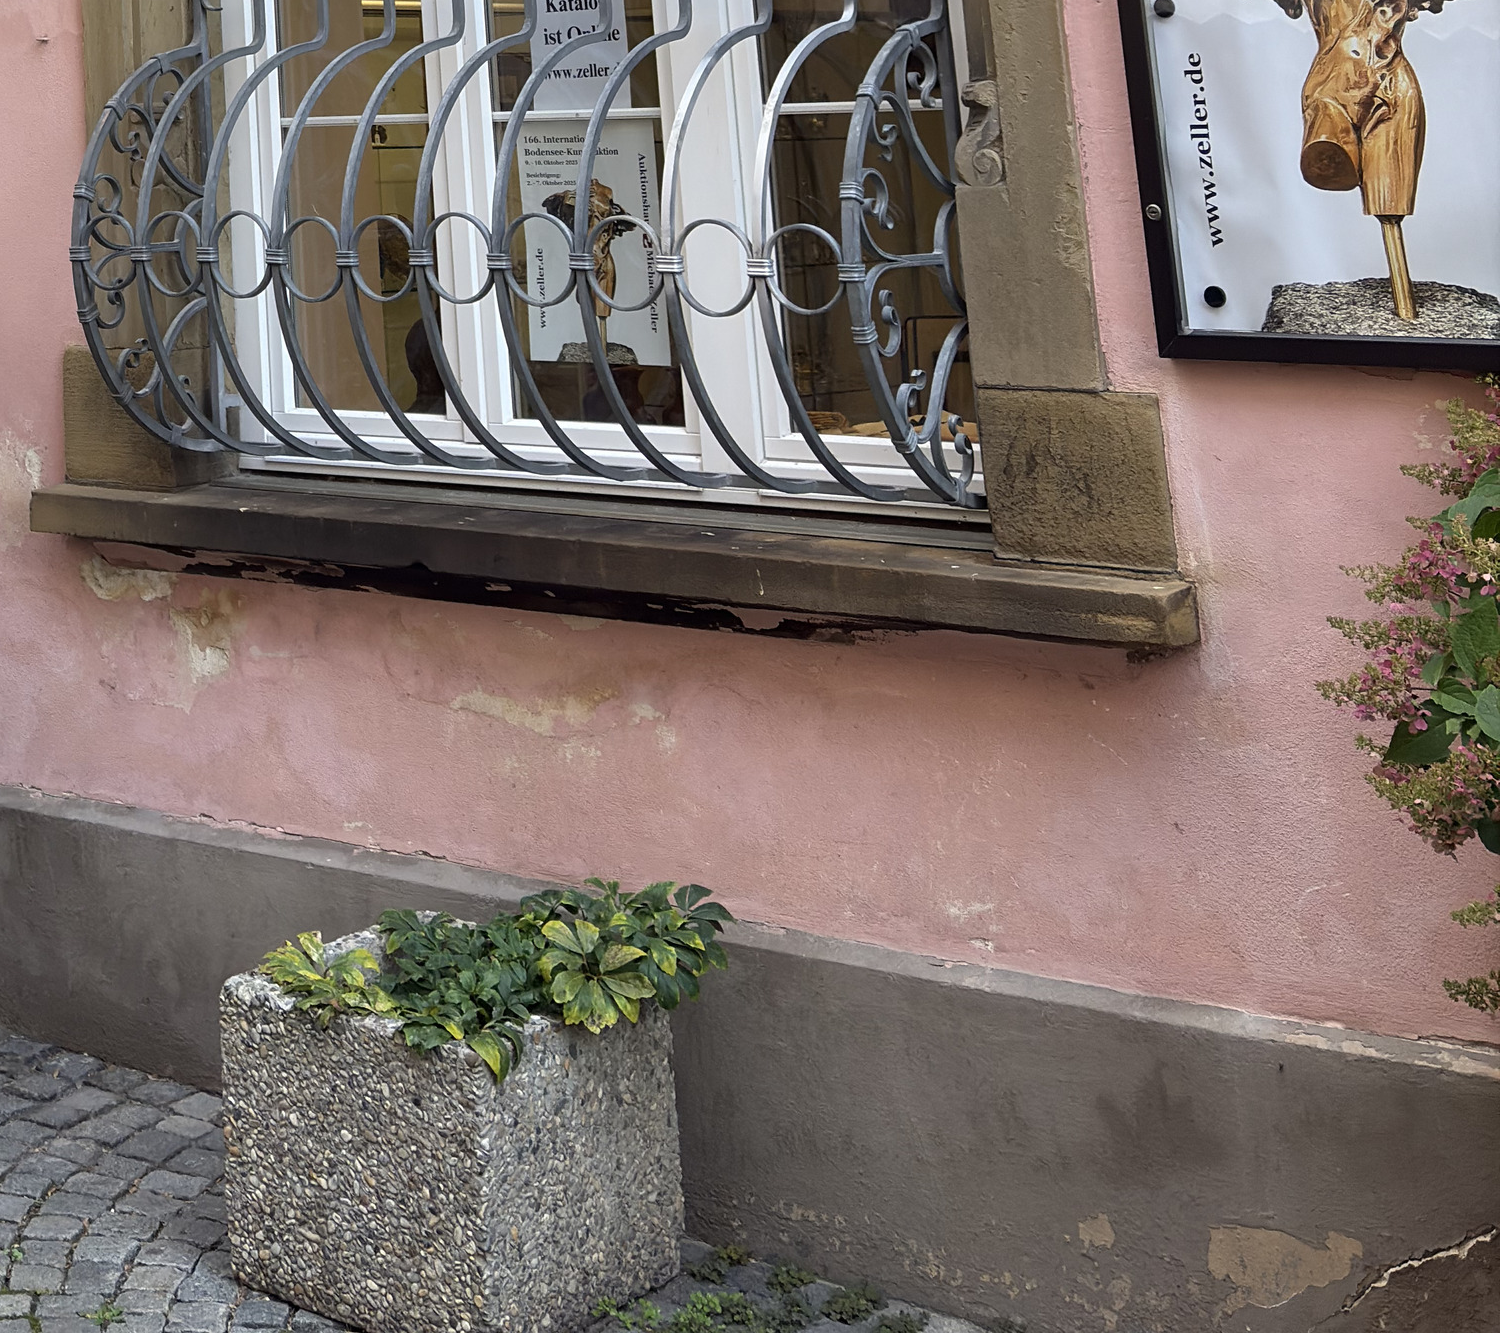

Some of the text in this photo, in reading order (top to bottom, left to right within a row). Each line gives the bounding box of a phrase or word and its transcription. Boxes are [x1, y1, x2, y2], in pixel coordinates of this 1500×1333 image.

[543, 27, 563, 46] ist
[524, 133, 586, 144] 166. Internatio
[524, 146, 619, 157] Bodensee-Kunktion
[1184, 52, 1224, 249] www.zeller.de
[638, 152, 650, 225] Auktionshau
[646, 250, 656, 294] Michae
